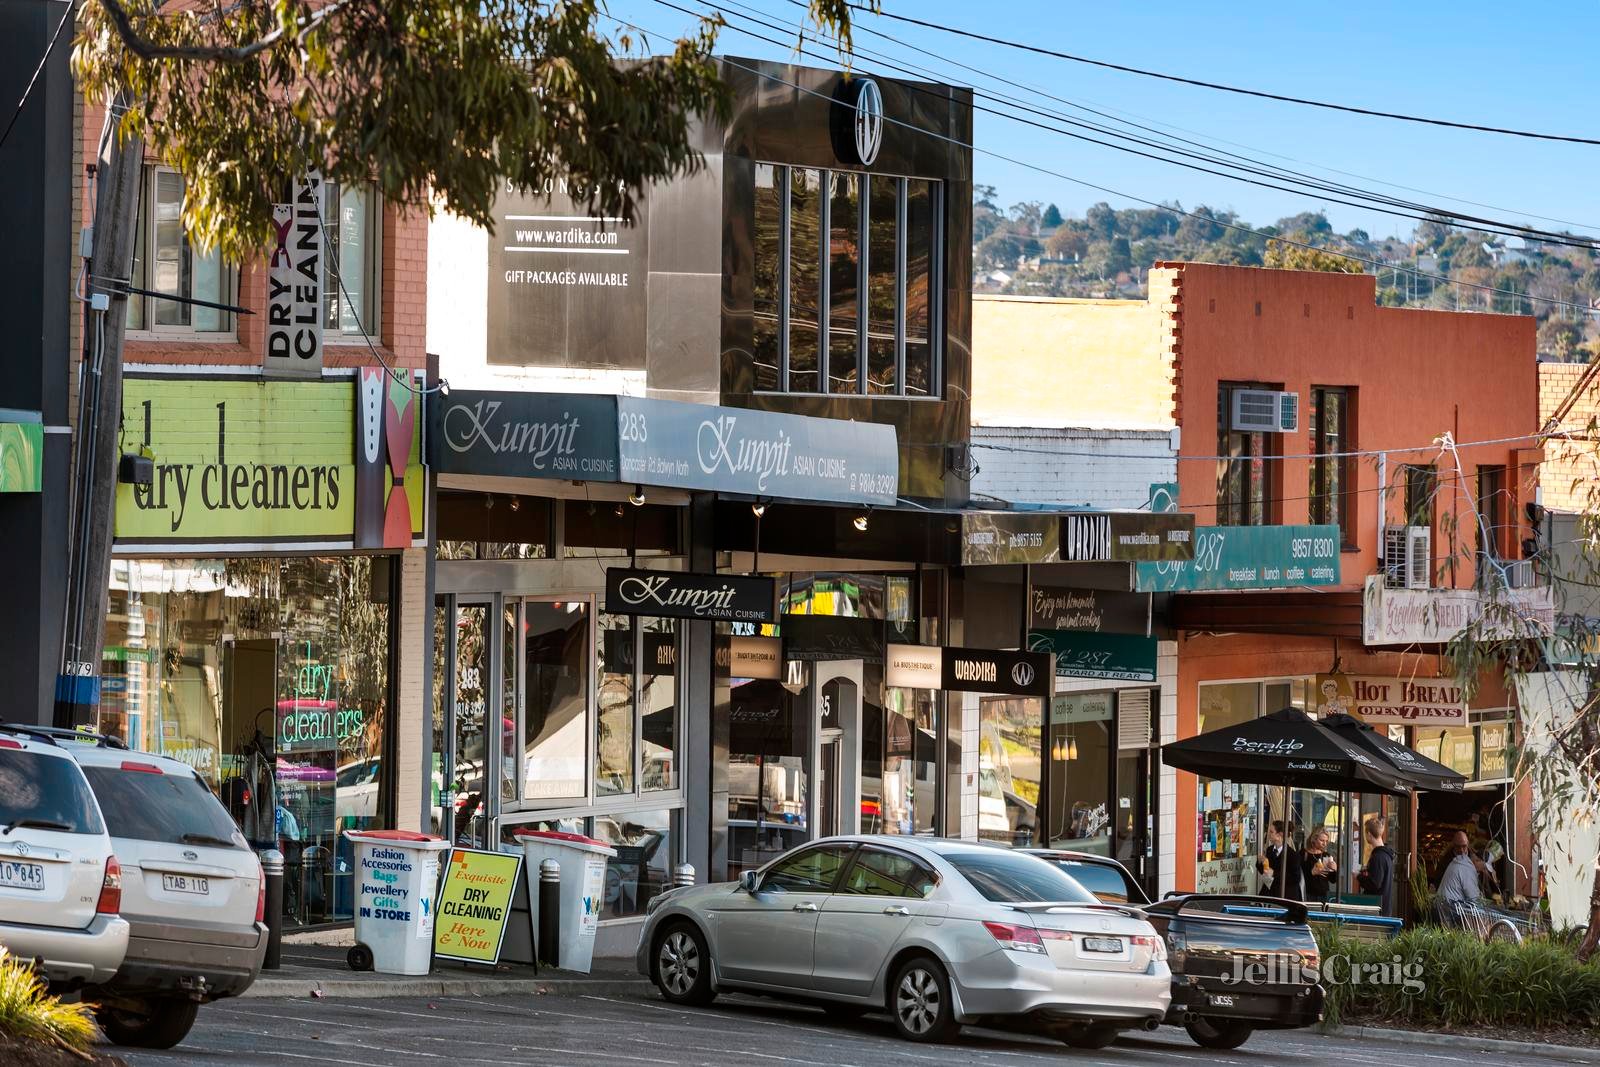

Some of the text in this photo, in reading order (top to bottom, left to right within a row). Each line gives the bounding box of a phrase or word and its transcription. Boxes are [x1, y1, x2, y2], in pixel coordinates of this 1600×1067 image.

[515, 228, 618, 245] www.wardika.com
[505, 270, 628, 286] GIFT PACKAGES AVAILABLE
[269, 276, 292, 358] DRY
[443, 399, 581, 470] Kunyit
[620, 412, 648, 443] 283
[201, 401, 340, 511] cleaners
[696, 413, 792, 492] Kunyit
[552, 457, 615, 473] ASIAN CUISINE
[792, 455, 846, 479] ASIAN CUISINE
[1067, 515, 1112, 561] WARDIKA
[1193, 531, 1226, 573] 287
[1292, 537, 1334, 559] 9857 8300
[1229, 565, 1335, 582] breakfast lunch coffee catering
[619, 575, 737, 616] Kunyit
[707, 608, 766, 619] ASIAN CUISINE
[1075, 650, 1113, 665] 287
[299, 640, 333, 706] dry
[954, 659, 997, 683] WARDIKA
[1096, 671, 1108, 679] AT
[1112, 672, 1141, 680] REAR
[1355, 680, 1462, 704] HOT BREAD
[282, 687, 364, 743] cleaners
[1361, 705, 1458, 719] OPEN 7 DAYS
[1232, 737, 1304, 750] Beraldo
[1482, 728, 1503, 751] Quality
[1287, 761, 1316, 771] Beraldo
[1482, 752, 1505, 772] Service
[371, 847, 405, 860] Fashion
[361, 857, 413, 872] Accessories
[21, 866, 41, 884] 845
[373, 870, 398, 884] Bags
[455, 871, 507, 885] Exquisite
[361, 883, 409, 899] Jewellery
[463, 887, 490, 903] DRY
[373, 896, 400, 909] Gifts
[443, 901, 502, 921] CLEANING
[360, 907, 411, 921] IN STORE
[450, 922, 486, 937] Here
[440, 933, 491, 950] & Now
